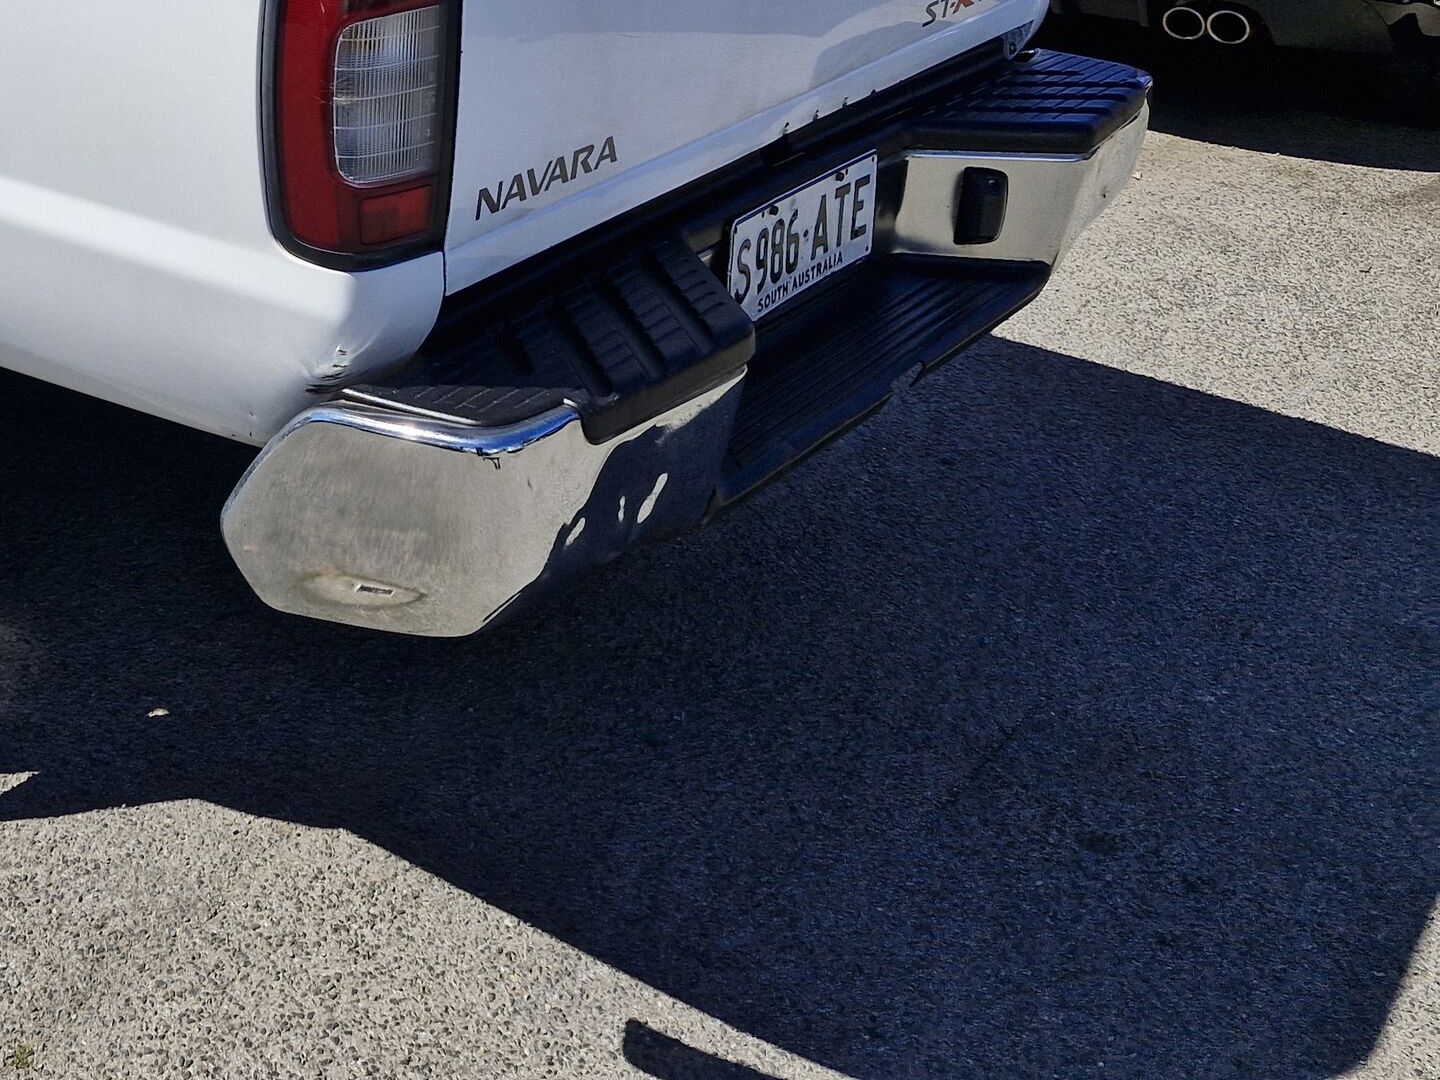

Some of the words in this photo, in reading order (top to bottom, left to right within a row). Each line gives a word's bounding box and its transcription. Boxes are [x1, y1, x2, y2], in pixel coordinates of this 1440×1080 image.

[475, 136, 618, 221] NAVARA
[757, 280, 789, 313] SOUTH
[791, 251, 843, 291] AUSTRALIA
